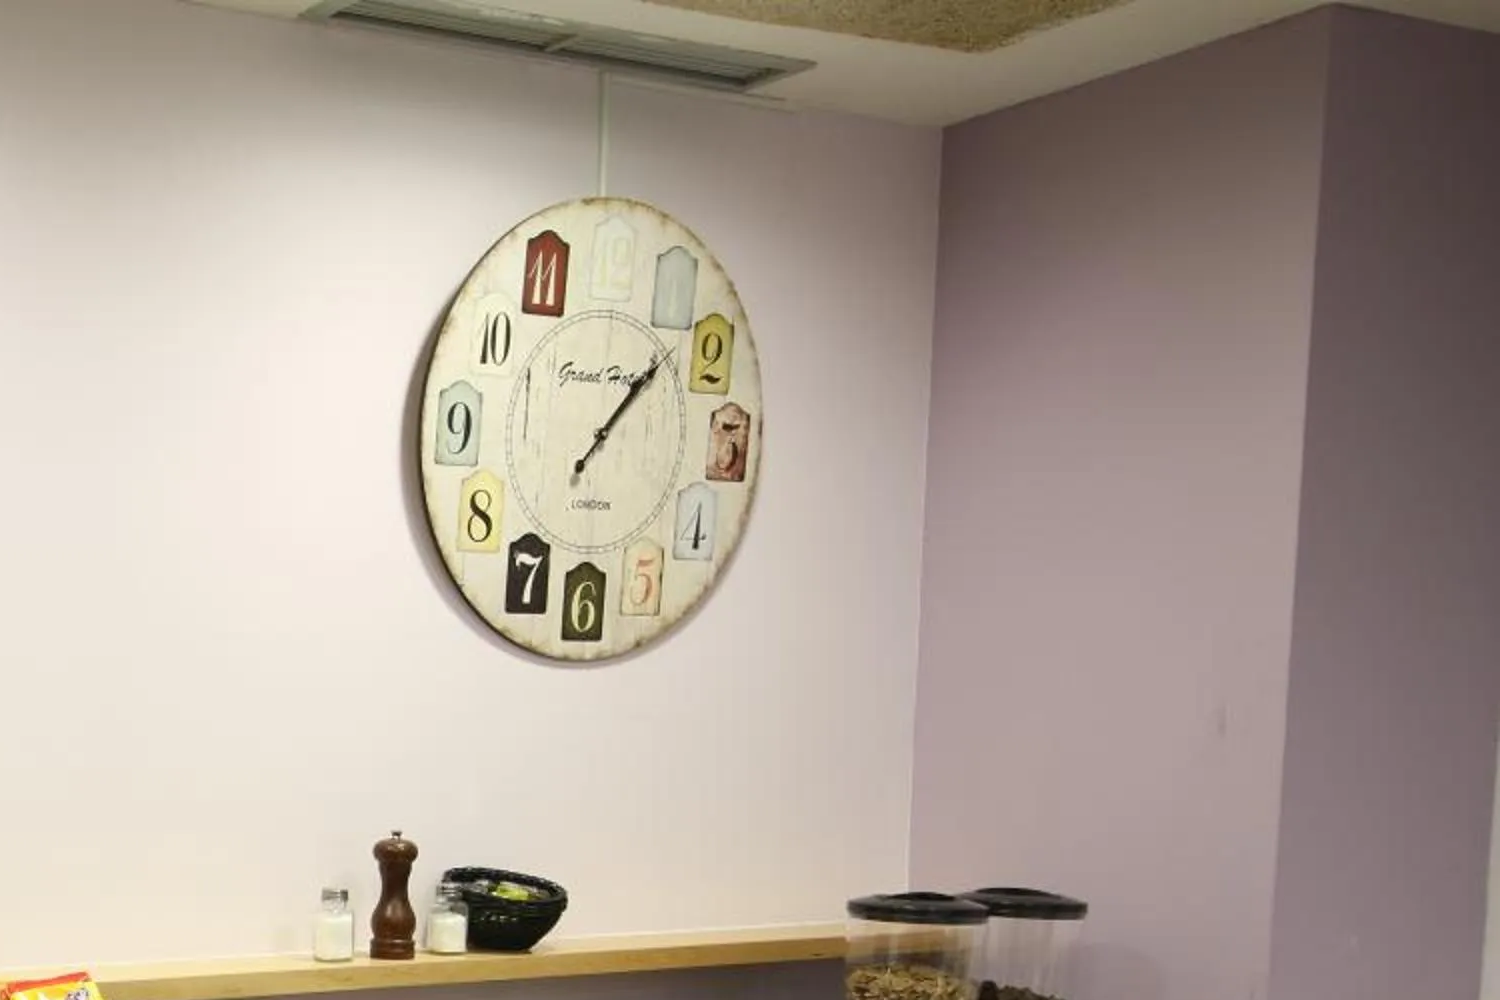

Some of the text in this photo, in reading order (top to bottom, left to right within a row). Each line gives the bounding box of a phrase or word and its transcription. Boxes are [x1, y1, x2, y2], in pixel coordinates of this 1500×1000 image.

[528, 249, 560, 307] 11
[478, 311, 512, 366] 10
[700, 333, 725, 384] 2
[447, 402, 473, 456] 9
[466, 489, 493, 543] 8
[679, 501, 707, 550] 4
[514, 553, 544, 605] 7
[630, 558, 654, 607] 5
[571, 581, 596, 633] 6
